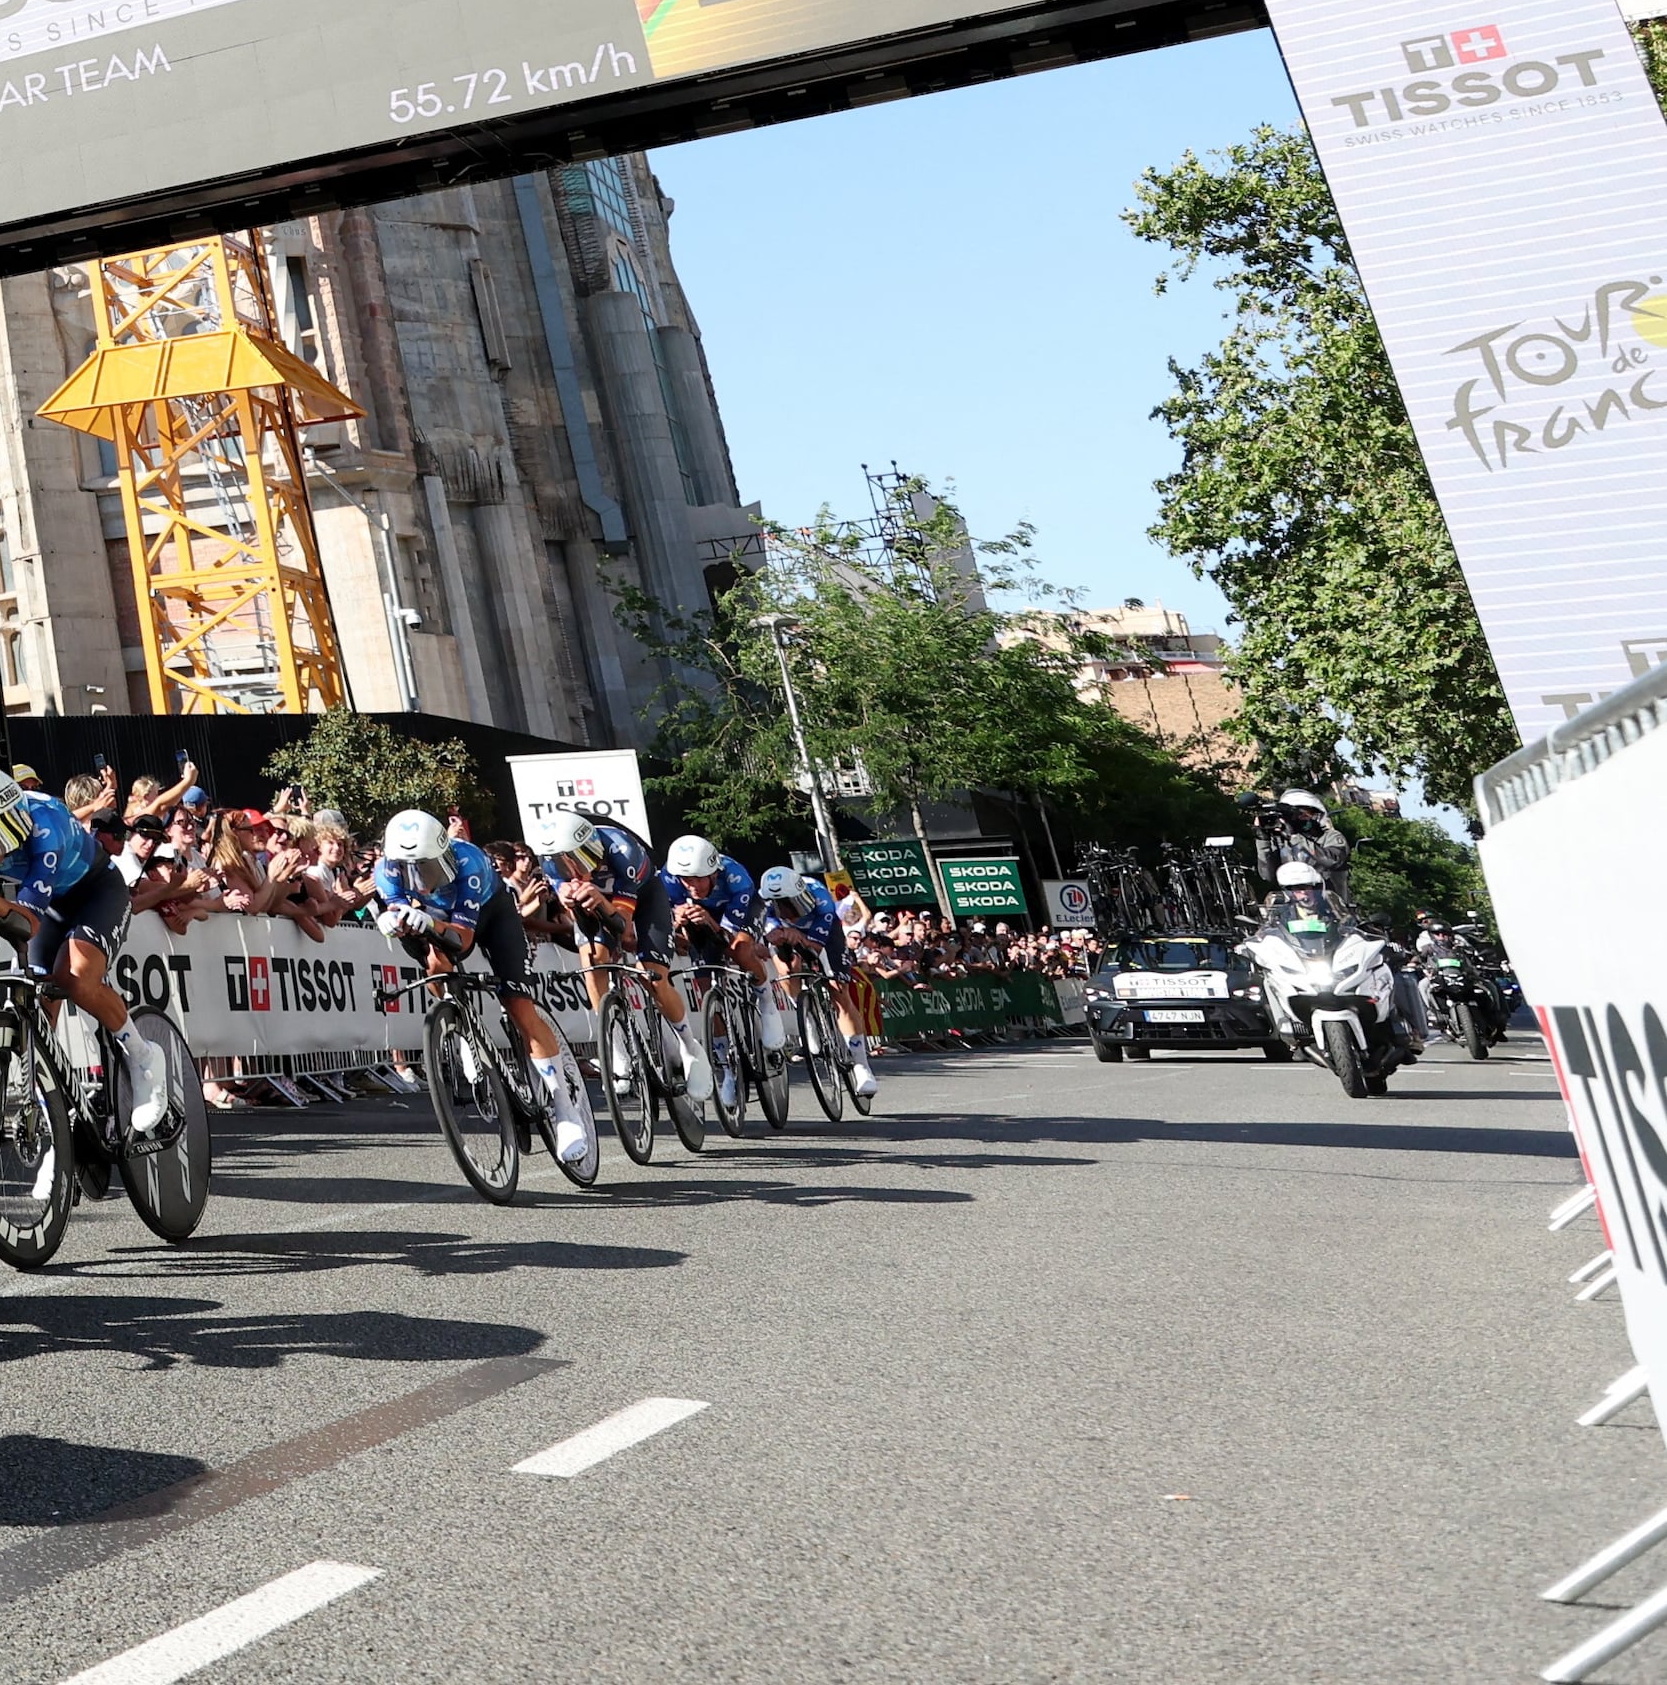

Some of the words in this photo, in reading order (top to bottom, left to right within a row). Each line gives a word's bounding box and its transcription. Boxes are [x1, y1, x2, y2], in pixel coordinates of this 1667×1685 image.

[62, 43, 172, 96] TEAM
[387, 69, 512, 124] 55.72
[523, 41, 638, 96] km/h
[1331, 48, 1605, 128] TISSOT
[1345, 129, 1404, 148] SWISS
[1409, 112, 1504, 136] WATCHES
[1510, 99, 1571, 120] SINCE
[1577, 90, 1624, 110] 1853
[1611, 343, 1649, 374] de
[1445, 370, 1667, 473] franc
[853, 866, 923, 882] SKODA
[949, 865, 1012, 878] SKODA
[953, 880, 1016, 893] SKODA
[858, 882, 929, 899] SKODA
[957, 895, 1020, 908] SKODA
[272, 957, 356, 1013] TISSOT
[1154, 978, 1209, 987] TISSOT
